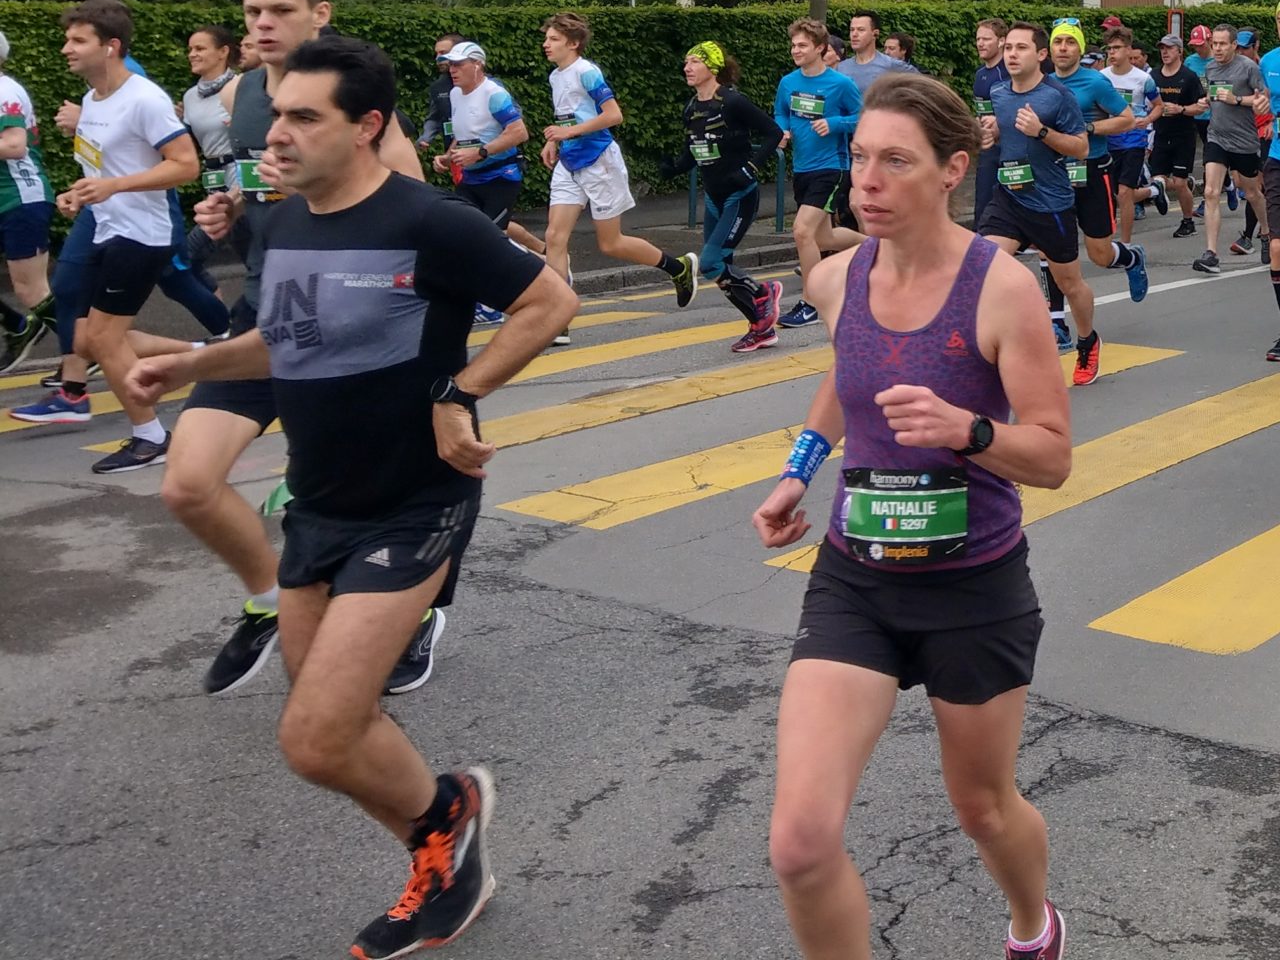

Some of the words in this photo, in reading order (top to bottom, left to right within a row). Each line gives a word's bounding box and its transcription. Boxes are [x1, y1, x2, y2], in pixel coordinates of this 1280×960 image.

[360, 273, 393, 281] GENEVA
[343, 280, 393, 288] MARATHON
[870, 500, 938, 516] NATHALIE
[900, 518, 929, 530] 5297
